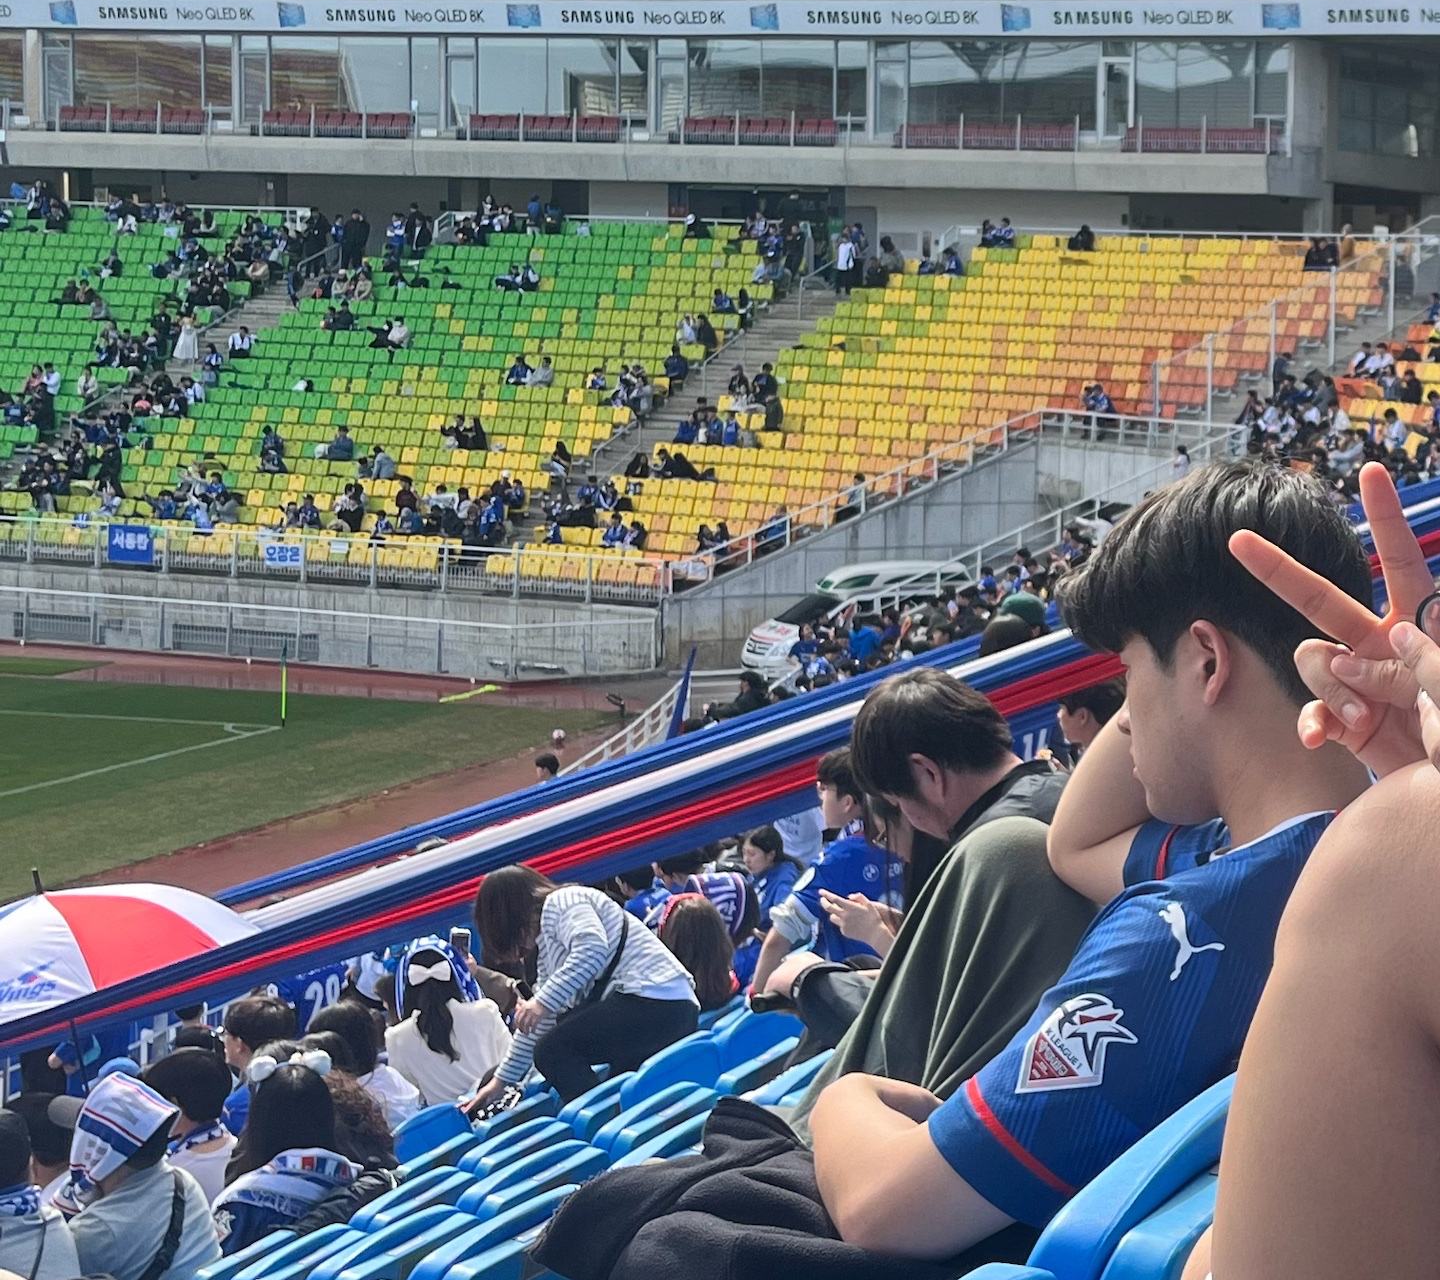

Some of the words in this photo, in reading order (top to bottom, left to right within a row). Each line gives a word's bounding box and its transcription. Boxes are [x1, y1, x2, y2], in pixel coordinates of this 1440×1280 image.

[98, 6, 168, 20] SAMSUNG
[176, 7, 204, 21] Neo
[205, 7, 238, 21] QLED
[240, 7, 255, 21] 8K
[326, 9, 396, 21] SAMSUNG
[405, 9, 432, 22] Neo
[434, 9, 467, 22] QLED
[469, 9, 485, 23] 8K
[561, 10, 635, 23] SAMSUNG
[643, 11, 672, 24] Neo
[673, 11, 707, 25] QLED
[710, 11, 726, 24] 8K
[806, 10, 882, 24] SAMSUNG
[891, 10, 923, 25] Neo
[925, 10, 960, 25] QLED
[962, 10, 980, 24] 8K
[1053, 10, 1133, 25] SAMSUNG
[1143, 10, 1174, 24] Neo
[1176, 10, 1214, 25] QLED
[1216, 10, 1234, 24] 8K
[1327, 9, 1410, 23] SAMSUNG
[1045, 1028, 1052, 1037] K
[1050, 1036, 1079, 1067] LEAGUE
